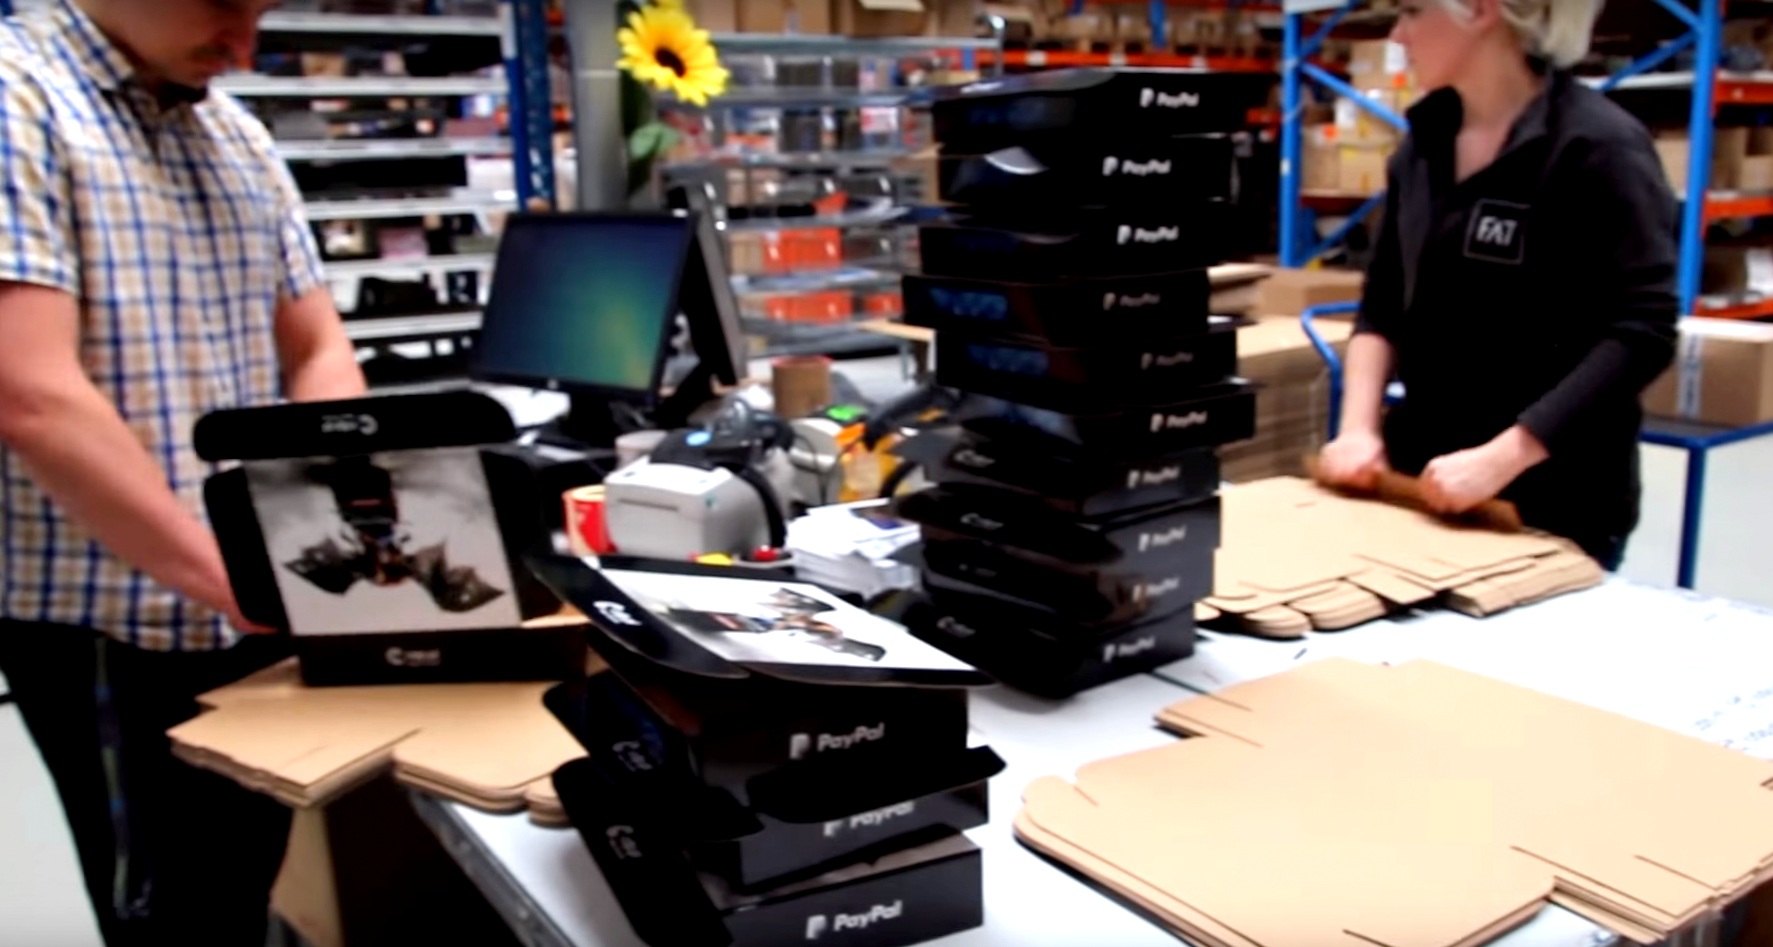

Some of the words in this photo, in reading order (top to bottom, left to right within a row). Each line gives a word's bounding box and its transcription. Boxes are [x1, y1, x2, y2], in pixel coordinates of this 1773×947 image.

[1157, 91, 1199, 108] PayPal
[1122, 159, 1171, 176] PayPal
[1135, 226, 1179, 243] PayPal
[1476, 215, 1517, 246] FAT
[1166, 410, 1207, 428] PayPal
[817, 722, 884, 752] PayPal
[834, 899, 902, 931] PayPal
